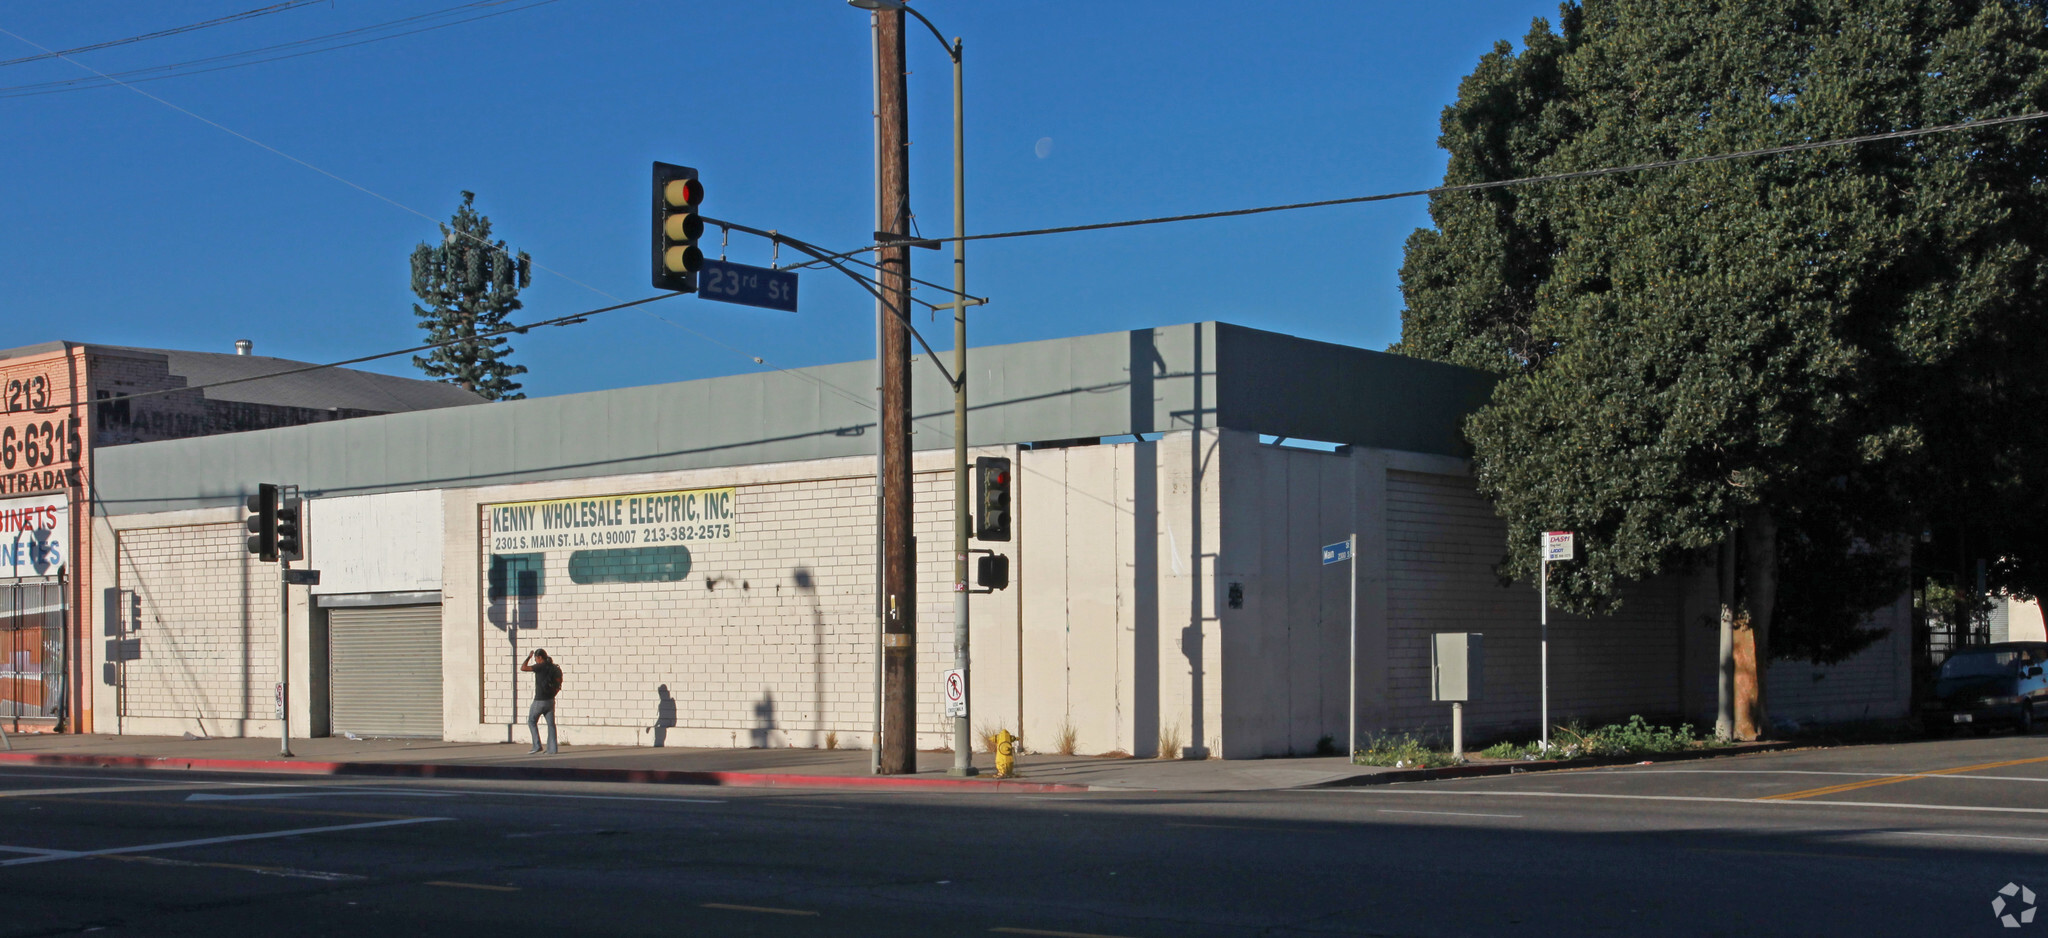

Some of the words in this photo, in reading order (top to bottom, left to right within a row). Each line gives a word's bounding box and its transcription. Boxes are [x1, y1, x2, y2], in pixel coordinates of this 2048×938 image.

[707, 268, 757, 296] 23rd
[768, 279, 790, 301] St
[4, 373, 51, 416] (213)
[493, 505, 536, 532] KENNY
[542, 499, 622, 530] WHOLESALE
[630, 494, 700, 525] ELECTRIC,
[705, 491, 733, 520] INC.
[495, 537, 518, 550] 2301
[520, 536, 529, 550] S.
[531, 534, 555, 549] MAIN
[558, 533, 571, 547] ST.
[574, 532, 589, 547] LA,
[591, 531, 604, 545] CA
[606, 530, 636, 545] 90007
[644, 524, 731, 543] 213-382-2575
